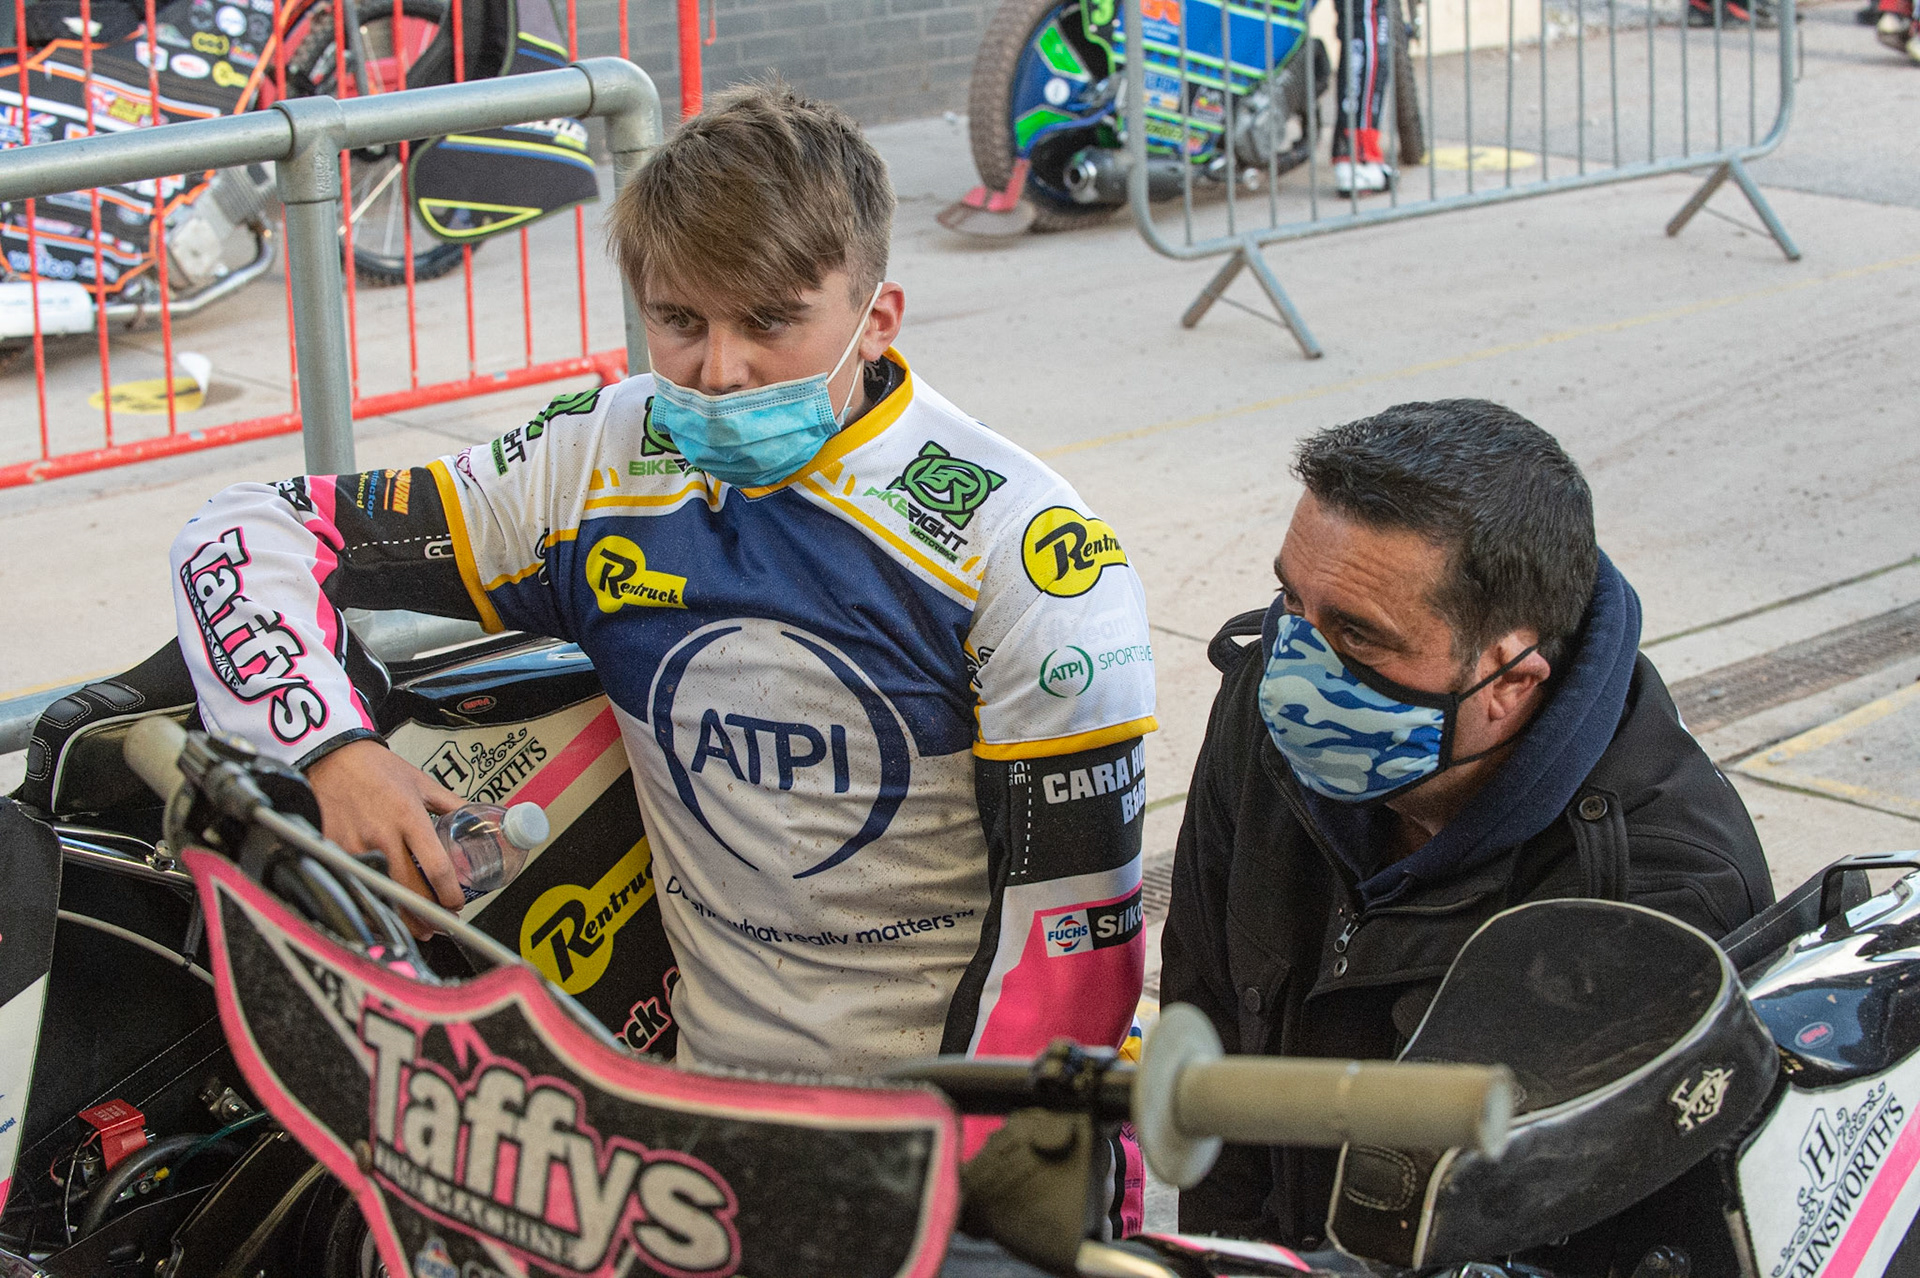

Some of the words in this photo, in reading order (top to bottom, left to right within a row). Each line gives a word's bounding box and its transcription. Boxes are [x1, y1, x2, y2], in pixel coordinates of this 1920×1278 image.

[189, 526, 327, 744] Taffys
[1048, 660, 1085, 684] ATPI
[690, 708, 850, 794] ATPI
[1042, 756, 1131, 805] CARA
[1047, 925, 1088, 942] FUCHS
[363, 1011, 733, 1272] Taffys
[1790, 1097, 1905, 1278] AINSWORTH'S
